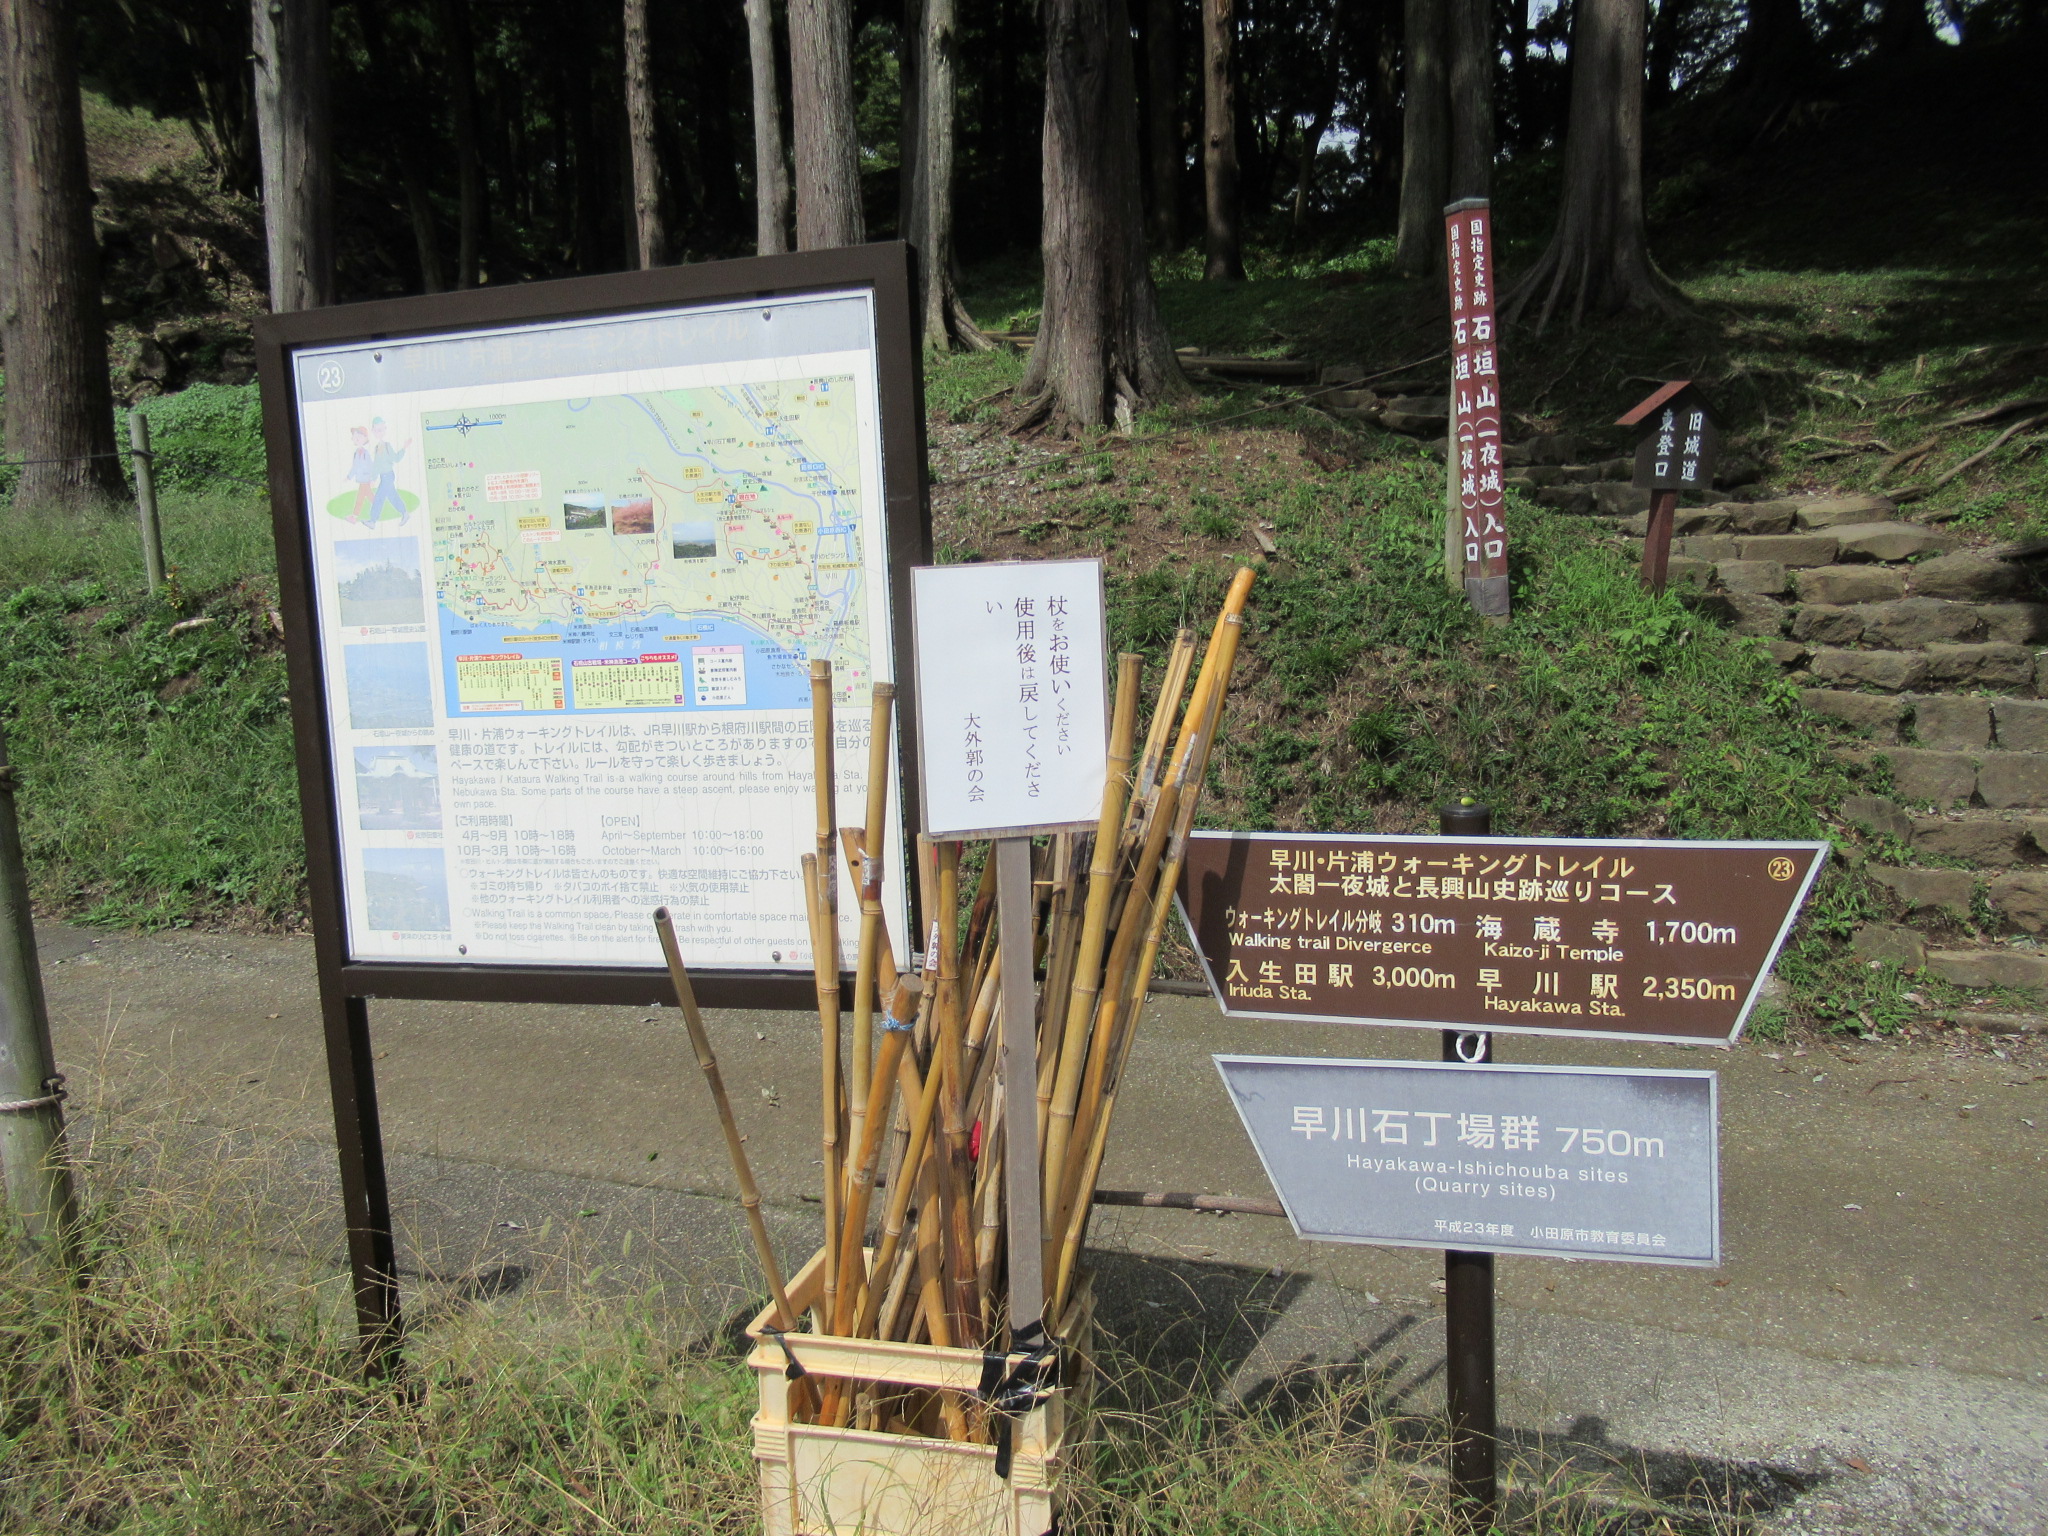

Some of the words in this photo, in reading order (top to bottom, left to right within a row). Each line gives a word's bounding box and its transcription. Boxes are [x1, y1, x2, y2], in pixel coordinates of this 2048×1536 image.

[319, 364, 343, 391] 23
[1655, 408, 1674, 476] 東登口
[1681, 411, 1703, 481] 旧城道
[986, 601, 1003, 614] い
[1047, 595, 1071, 755] 杖をお使いください
[1014, 597, 1041, 798] 使用後は戻してくださ
[964, 713, 985, 802] 大外郭の会
[452, 775, 496, 786] Hayakawa
[507, 774, 541, 784] Kataura
[545, 774, 579, 786] Walking
[583, 773, 603, 784] Trail
[607, 773, 615, 783] is
[619, 775, 625, 783] a
[629, 773, 662, 785] walking
[668, 773, 698, 782] course
[703, 772, 735, 781] around
[739, 771, 758, 781] hills
[762, 771, 783, 780] from
[843, 770, 863, 780] Sta.
[453, 787, 497, 797] Nebukawa
[500, 786, 517, 796] Sta.
[521, 786, 547, 796] Some
[550, 786, 572, 797] parts
[575, 786, 584, 795] of
[587, 785, 600, 795] the
[604, 787, 634, 796] course
[637, 785, 659, 795] have
[663, 787, 670, 795] a
[673, 786, 698, 796] steep
[702, 784, 736, 795] ascent,
[739, 784, 770, 795] please
[774, 783, 799, 795] enjoy
[843, 784, 853, 793] at
[454, 801, 471, 809] own
[473, 800, 497, 810] pace.
[1269, 849, 1636, 879] 早川・片浦ウォーキングトレイル
[1770, 858, 1792, 879] 23
[1269, 872, 1677, 905] 太閤一夜城と長興山史跡巡りコース
[507, 909, 525, 918] Trail
[527, 909, 535, 918] is
[545, 910, 581, 919] common
[584, 911, 613, 921] space.
[614, 910, 643, 919] Please
[693, 912, 701, 920] in
[704, 912, 757, 922] comfortable
[759, 913, 787, 923] space
[509, 921, 533, 931] keep
[534, 921, 542, 930] the
[544, 921, 574, 932] Walking
[576, 922, 594, 931] Trail
[595, 922, 616, 931] clean
[618, 923, 628, 933] by
[629, 923, 653, 934] taking
[675, 924, 695, 933] trash
[697, 924, 714, 933] with
[716, 926, 734, 935] you.
[1225, 905, 1382, 934] ウォーキングトレイル分岐
[1391, 912, 1456, 935] 310m
[1645, 920, 1736, 946] 1,700m
[495, 933, 507, 941] not
[509, 933, 525, 942] toss
[527, 933, 566, 944] cigarettes.
[590, 935, 600, 943] on
[602, 934, 614, 943] the
[615, 934, 633, 943] alert
[635, 934, 646, 943] for
[691, 936, 732, 946] respectful
[734, 936, 742, 945] of
[744, 937, 765, 945] other
[767, 937, 795, 947] guests
[797, 938, 808, 946] on
[1229, 932, 1291, 950] Walking
[1298, 934, 1331, 950] trail
[1484, 941, 1550, 960] Kaizo-ji
[1556, 945, 1624, 962] Temple
[1225, 959, 1354, 988] 入生田駅
[1372, 965, 1456, 990] 3,000m
[1642, 976, 1736, 1001] 2,350m
[1229, 983, 1274, 999] Iriuda
[1279, 985, 1312, 1001] Sta.
[1484, 995, 1582, 1015] Hayakawa
[1589, 1000, 1626, 1017] Sta.
[1291, 1104, 1540, 1151] 早川石丁場群
[1555, 1125, 1665, 1158] 750m
[1346, 1154, 1569, 1180] Hayakawa-Ishichouba
[1578, 1165, 1629, 1183] sites
[1414, 1176, 1490, 1198] (Quarry
[1499, 1180, 1556, 1201] sites)
[1434, 1219, 1514, 1238] 平成23年度
[1530, 1225, 1667, 1248] 小田原市教育委員会
